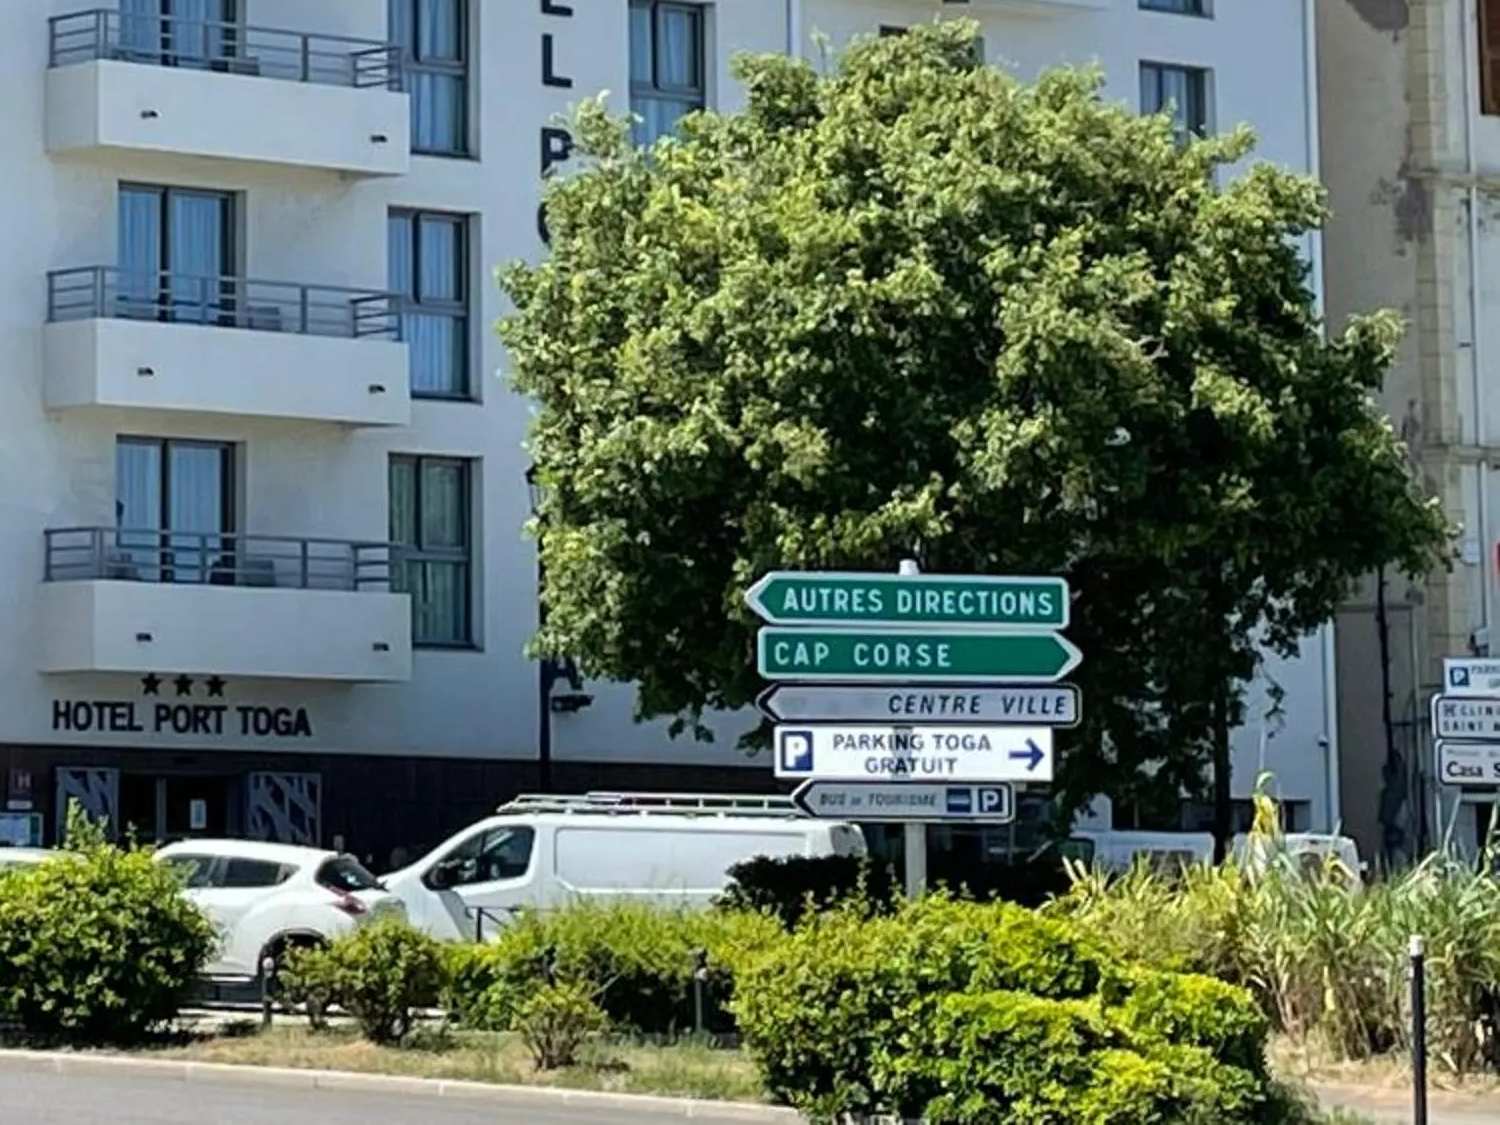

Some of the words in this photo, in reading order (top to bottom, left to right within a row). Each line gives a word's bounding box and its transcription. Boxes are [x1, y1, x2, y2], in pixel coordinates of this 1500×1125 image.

[783, 588, 882, 613] AUTRES
[897, 590, 1053, 616] DIRECTIONS
[774, 642, 829, 666] CAP
[854, 643, 952, 668] CORSE
[889, 695, 981, 715] CENTRE
[1001, 696, 1066, 716] VILLE
[52, 700, 143, 732] HOTEL
[155, 704, 228, 734] PORT
[236, 706, 312, 737] TOGA
[833, 734, 924, 751] PARKING
[933, 734, 992, 751] TOGA
[865, 757, 958, 774] GRATUIT
